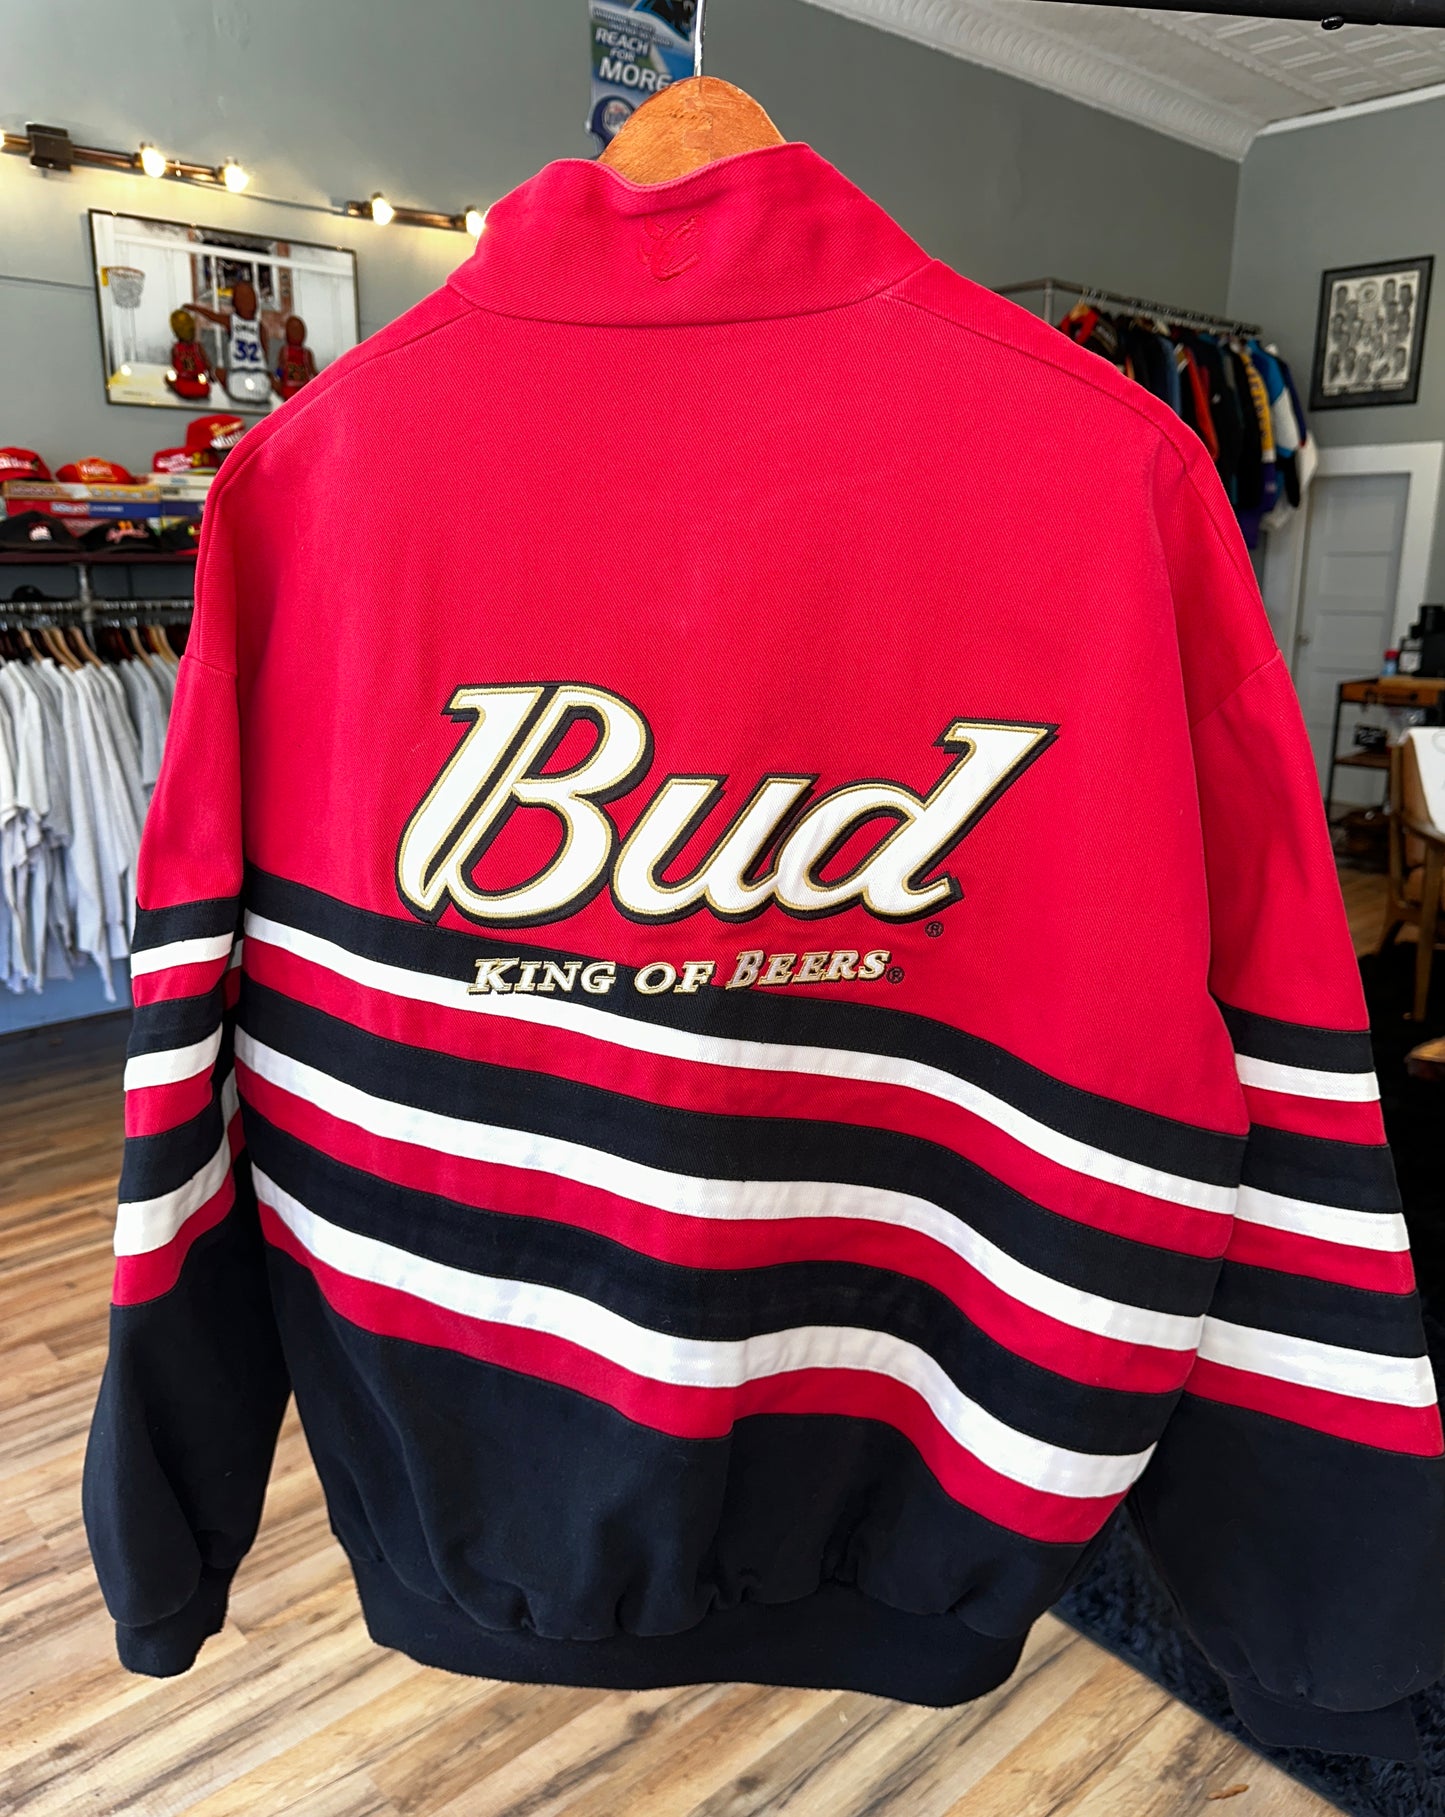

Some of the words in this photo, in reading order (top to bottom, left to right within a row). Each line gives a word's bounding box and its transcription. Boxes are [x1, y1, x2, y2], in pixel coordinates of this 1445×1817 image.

[595, 27, 650, 56] REACH
[609, 48, 635, 63] FOR
[600, 56, 672, 92] MORE
[234, 340, 260, 362] 32
[395, 681, 1060, 925] Bud
[467, 957, 617, 995] KING
[633, 961, 716, 995] OF
